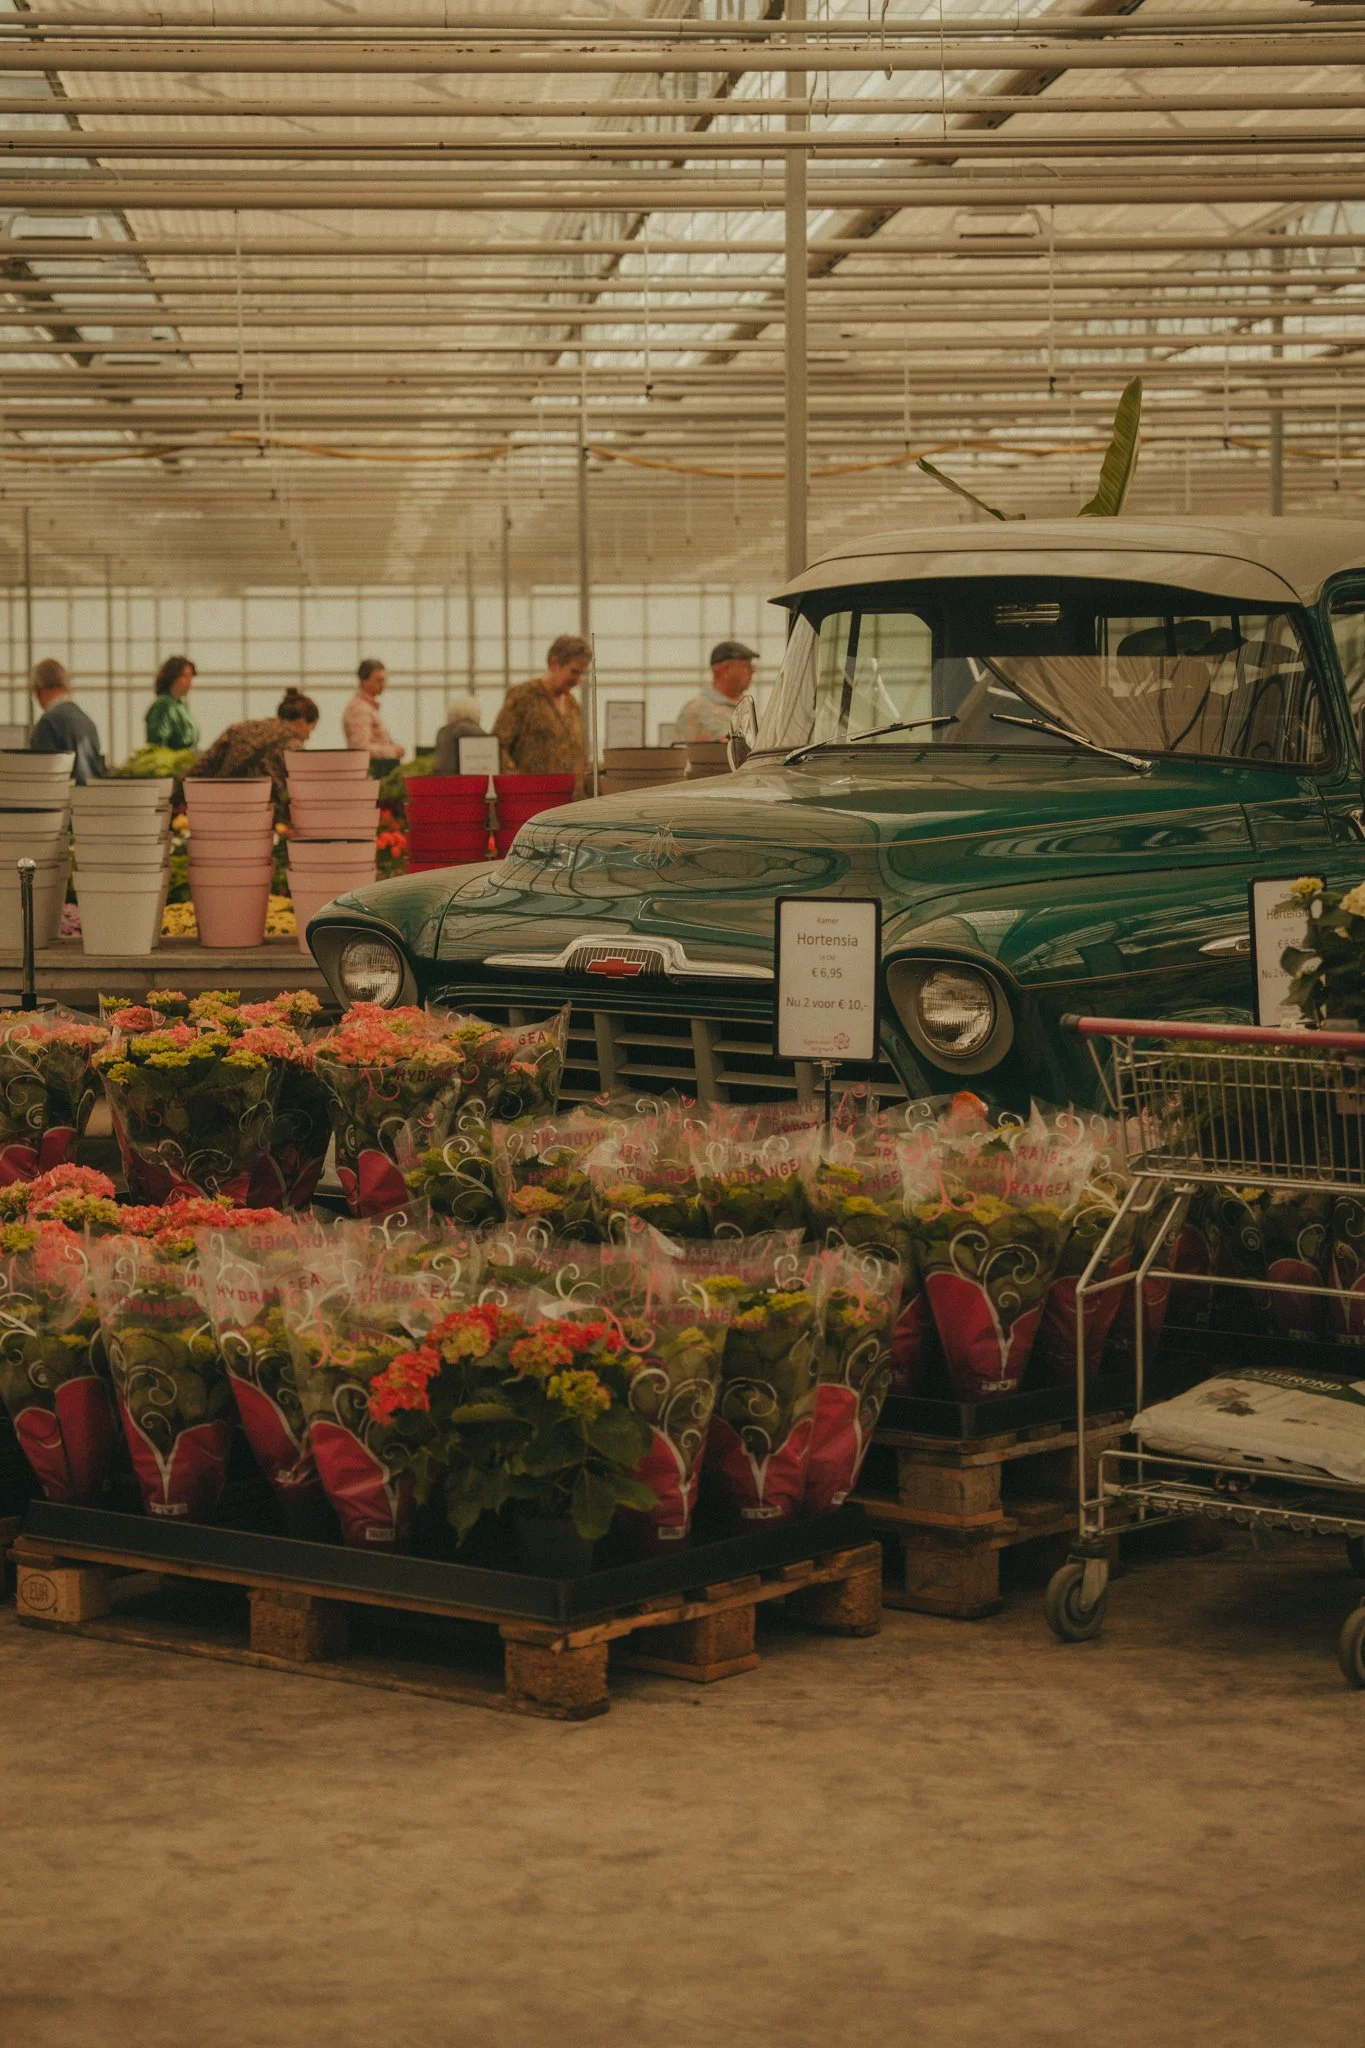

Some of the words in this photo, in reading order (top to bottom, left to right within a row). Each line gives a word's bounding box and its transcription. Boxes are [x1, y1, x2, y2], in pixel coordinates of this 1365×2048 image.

[797, 932, 858, 947] Hortensia
[811, 967, 818, 978] €
[820, 967, 843, 980] 6,95
[786, 996, 801, 1007] Nu
[804, 997, 810, 1008] 2
[812, 1000, 835, 1009] voor
[838, 999, 845, 1009] €
[848, 999, 869, 1012] 10,-
